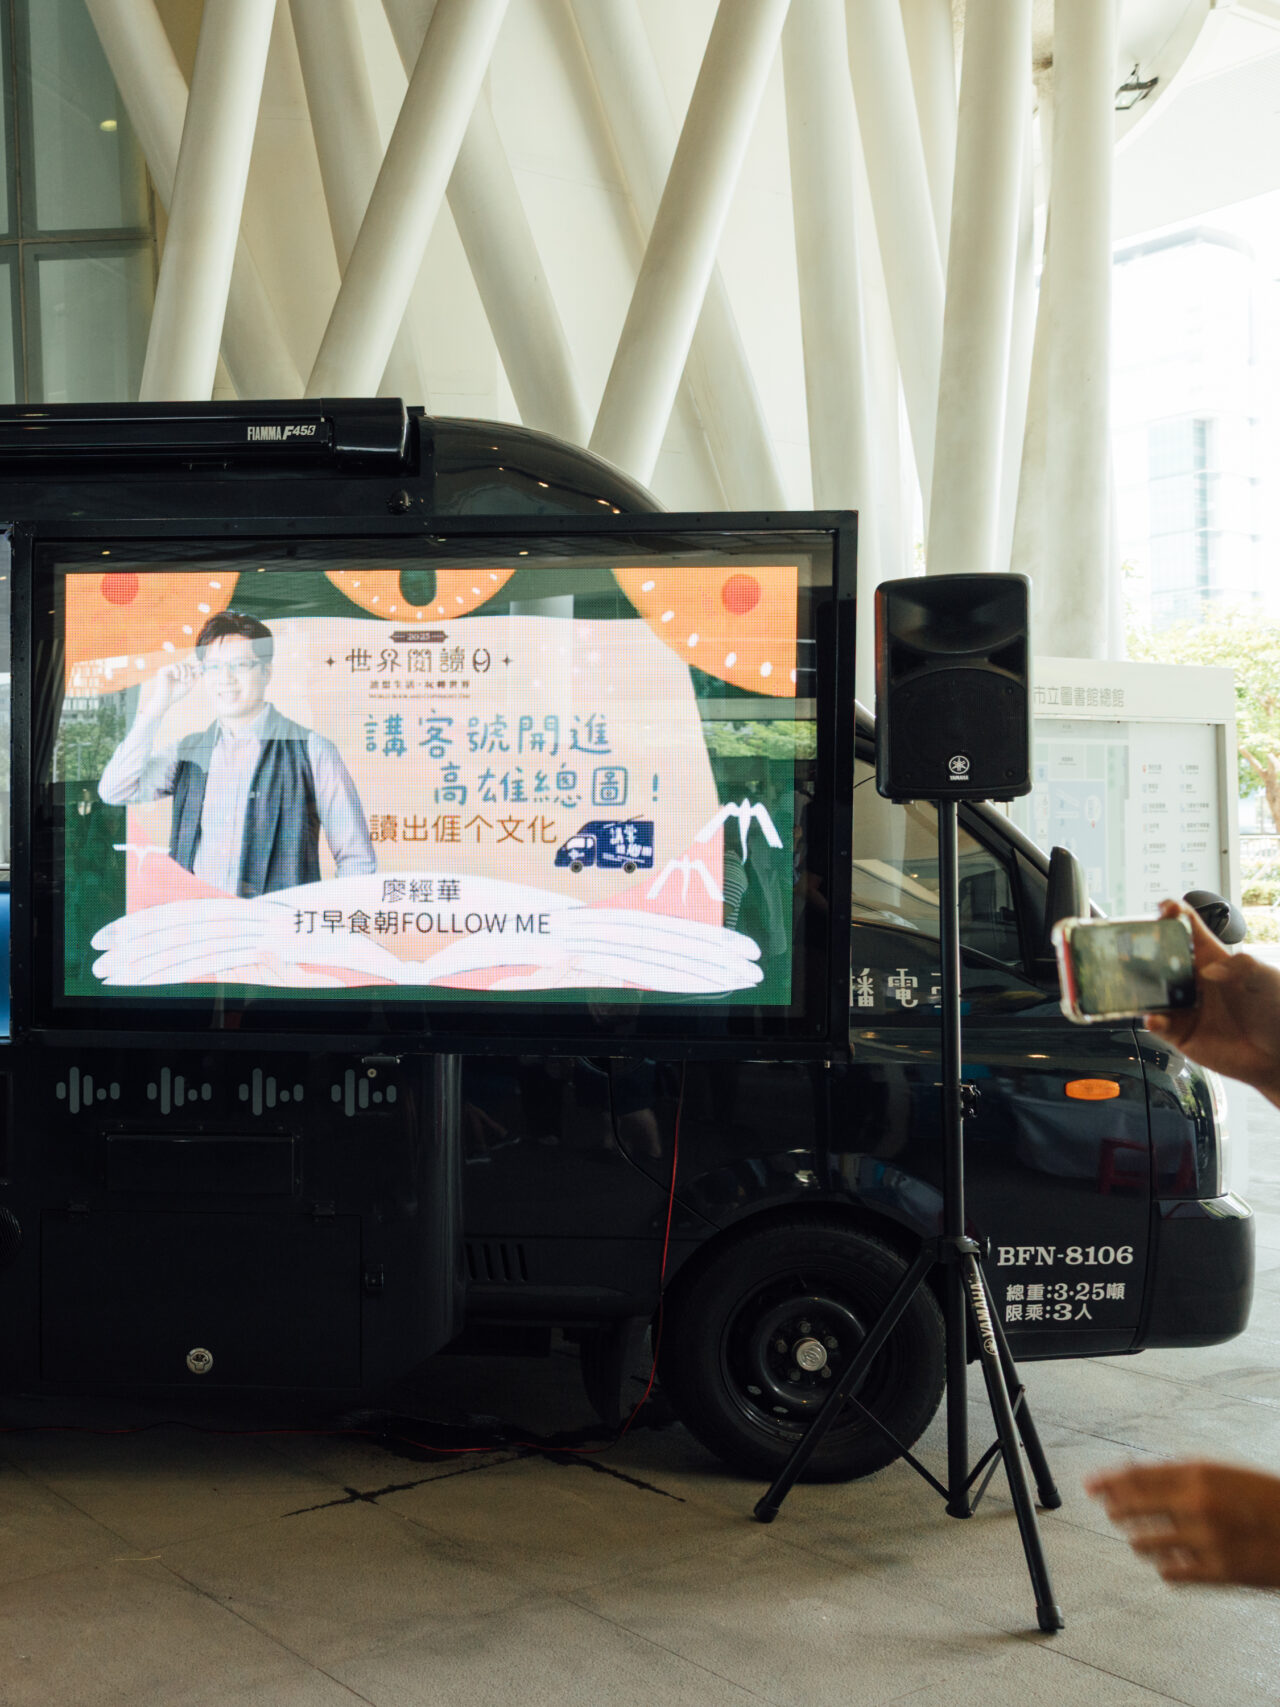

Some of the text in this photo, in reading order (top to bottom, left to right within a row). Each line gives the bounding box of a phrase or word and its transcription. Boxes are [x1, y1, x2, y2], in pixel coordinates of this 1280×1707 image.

[248, 426, 281, 441] FIAMMA
[345, 646, 491, 673] 世界閱讀日
[364, 709, 612, 758] 講客號開進
[382, 879, 461, 903] 廖經華
[516, 914, 551, 934] ME
[997, 1246, 1134, 1266] BFN-8106
